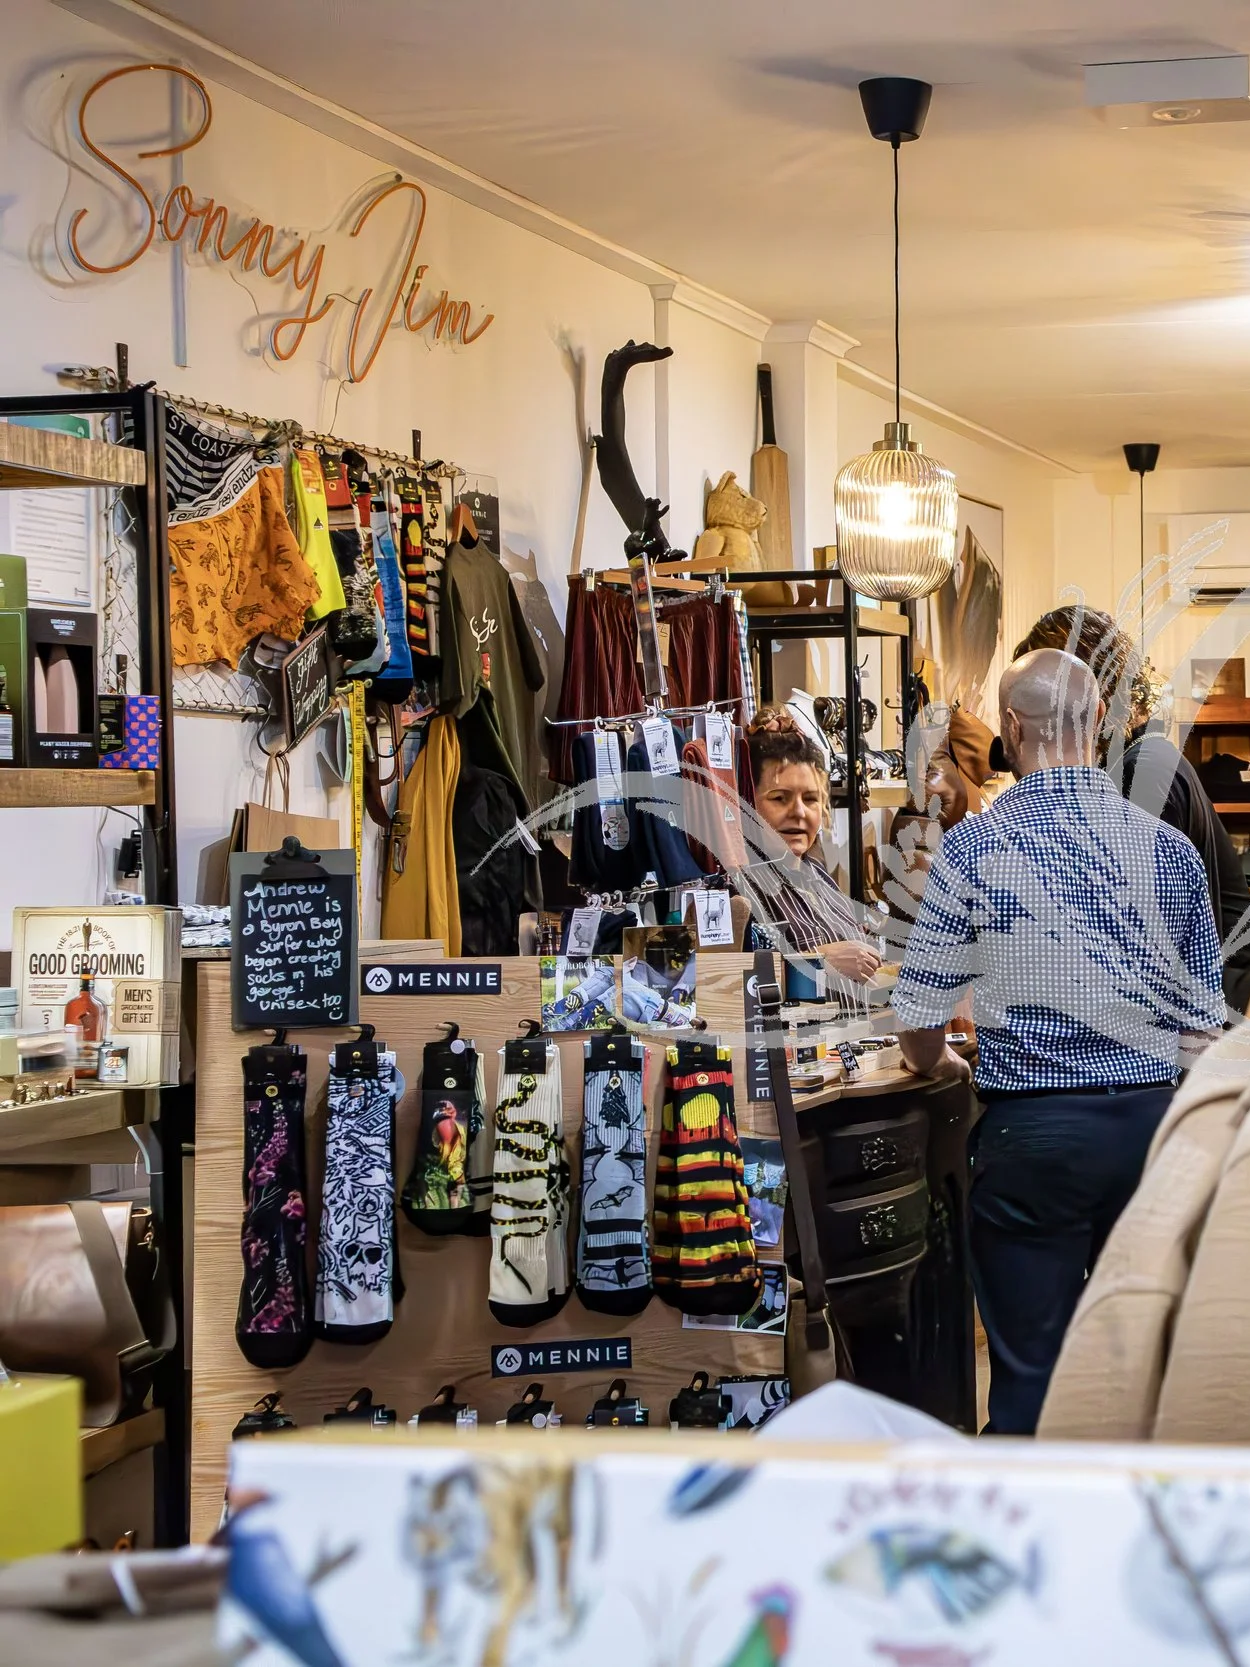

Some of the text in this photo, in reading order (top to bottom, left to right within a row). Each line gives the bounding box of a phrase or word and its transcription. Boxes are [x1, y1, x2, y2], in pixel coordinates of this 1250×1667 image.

[72, 64, 495, 384] Sonny Jim
[191, 432, 236, 458] COAST
[244, 882, 326, 898] Andrew
[247, 896, 342, 919] Mennie is
[56, 936, 68, 951] THE
[93, 925, 112, 942] BOOK
[242, 917, 343, 942] a Byron Bay
[306, 934, 337, 949] who
[29, 953, 145, 975] GOOD GROOMING
[244, 949, 342, 972] began creating
[247, 969, 287, 986] socks
[314, 964, 334, 978] his
[398, 972, 498, 987] MENNIE
[124, 989, 152, 1002] MEN'S
[321, 993, 342, 1008] too
[122, 1012, 153, 1024] GIFT SET
[528, 1346, 628, 1366] MENNIE
